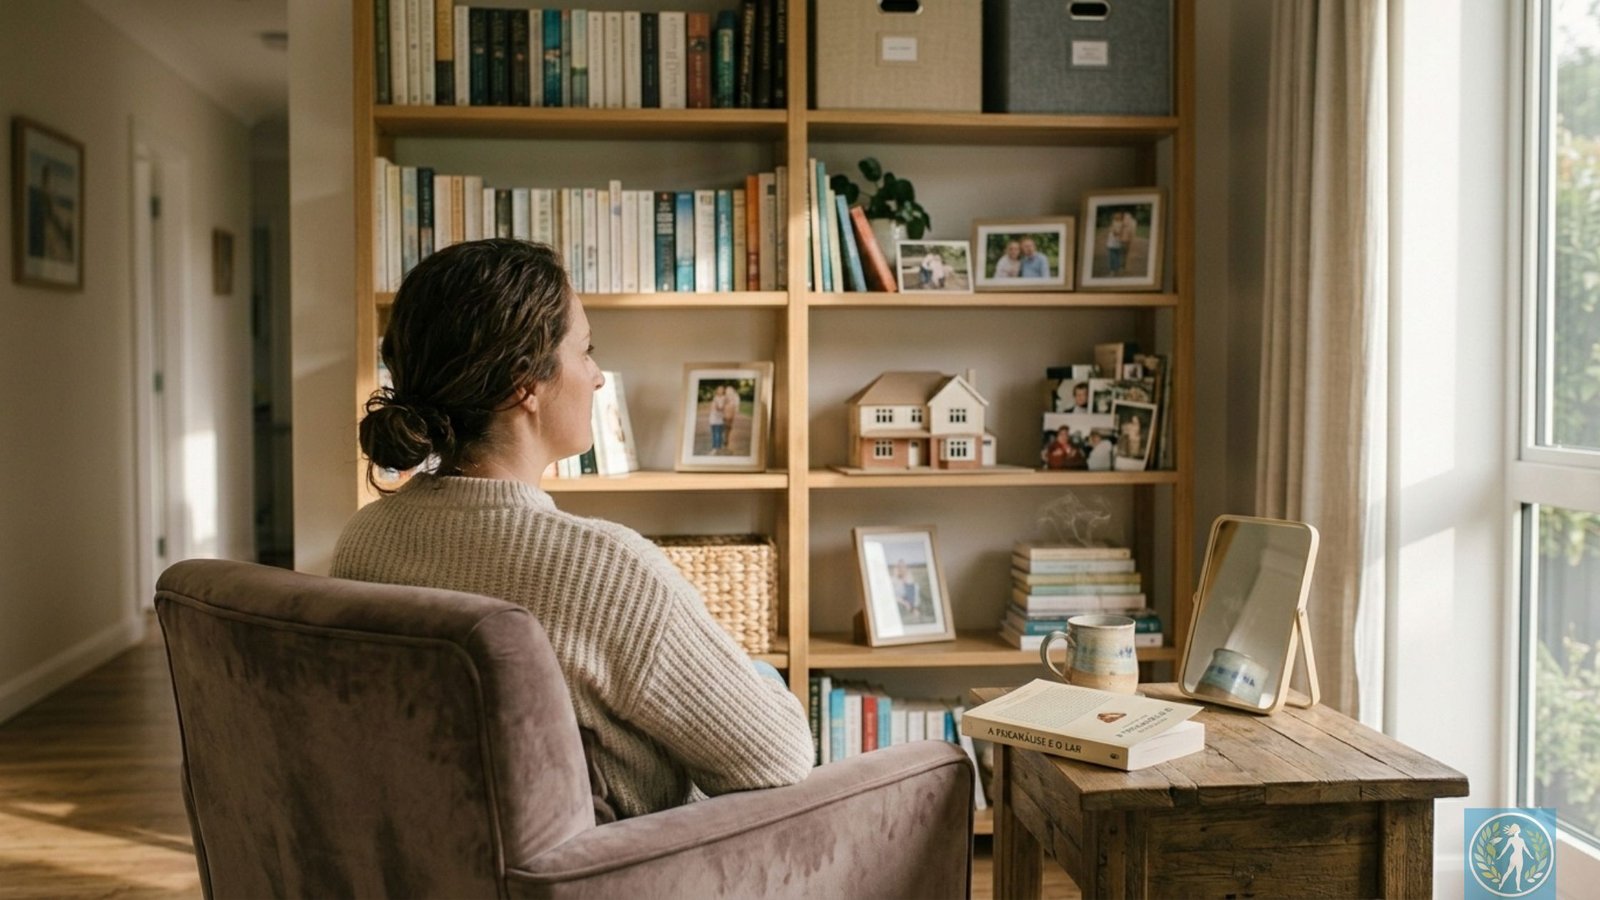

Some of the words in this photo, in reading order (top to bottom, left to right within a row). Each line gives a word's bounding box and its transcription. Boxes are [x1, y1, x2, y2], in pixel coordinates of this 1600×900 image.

[1048, 739, 1054, 748] E
[1055, 741, 1062, 750] O
[1065, 742, 1082, 753] LAR
